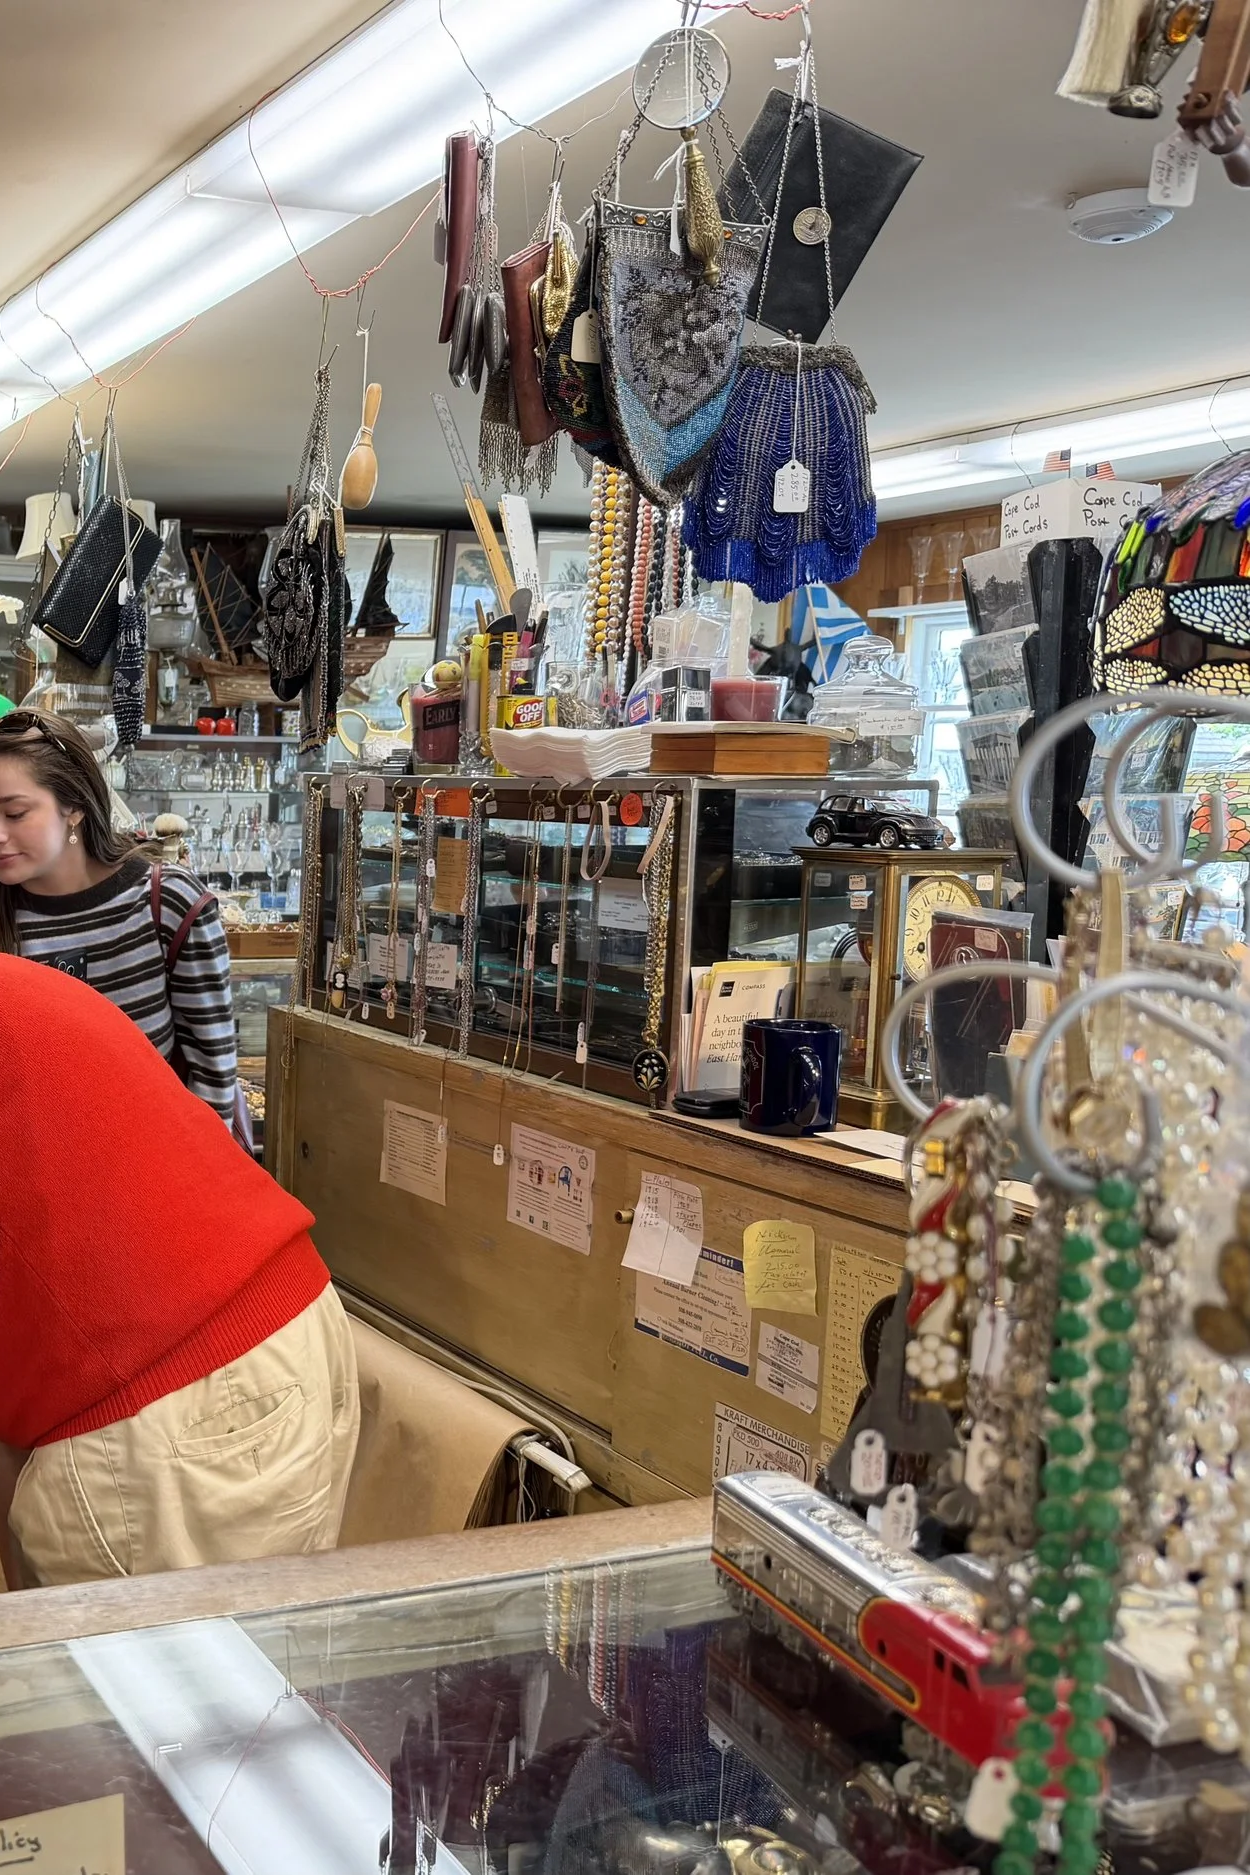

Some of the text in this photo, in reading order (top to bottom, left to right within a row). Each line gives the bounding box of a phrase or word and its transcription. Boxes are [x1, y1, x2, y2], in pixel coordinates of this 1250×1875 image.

[1023, 493, 1041, 511] Cod
[1082, 487, 1143, 509] Cape Cod
[1082, 508, 1110, 527] Post
[1003, 524, 1019, 540] Post
[519, 712, 541, 723] OFF
[741, 983, 766, 991] COMPASS
[713, 1011, 759, 1024] A beautiful
[711, 1028, 736, 1038] day in
[706, 1053, 724, 1064] East
[766, 1262, 800, 1271] 215.00
[724, 1407, 811, 1456] KRAFT MERCHANDISE
[747, 1435, 760, 1448] 500
[745, 1451, 755, 1466] 17
